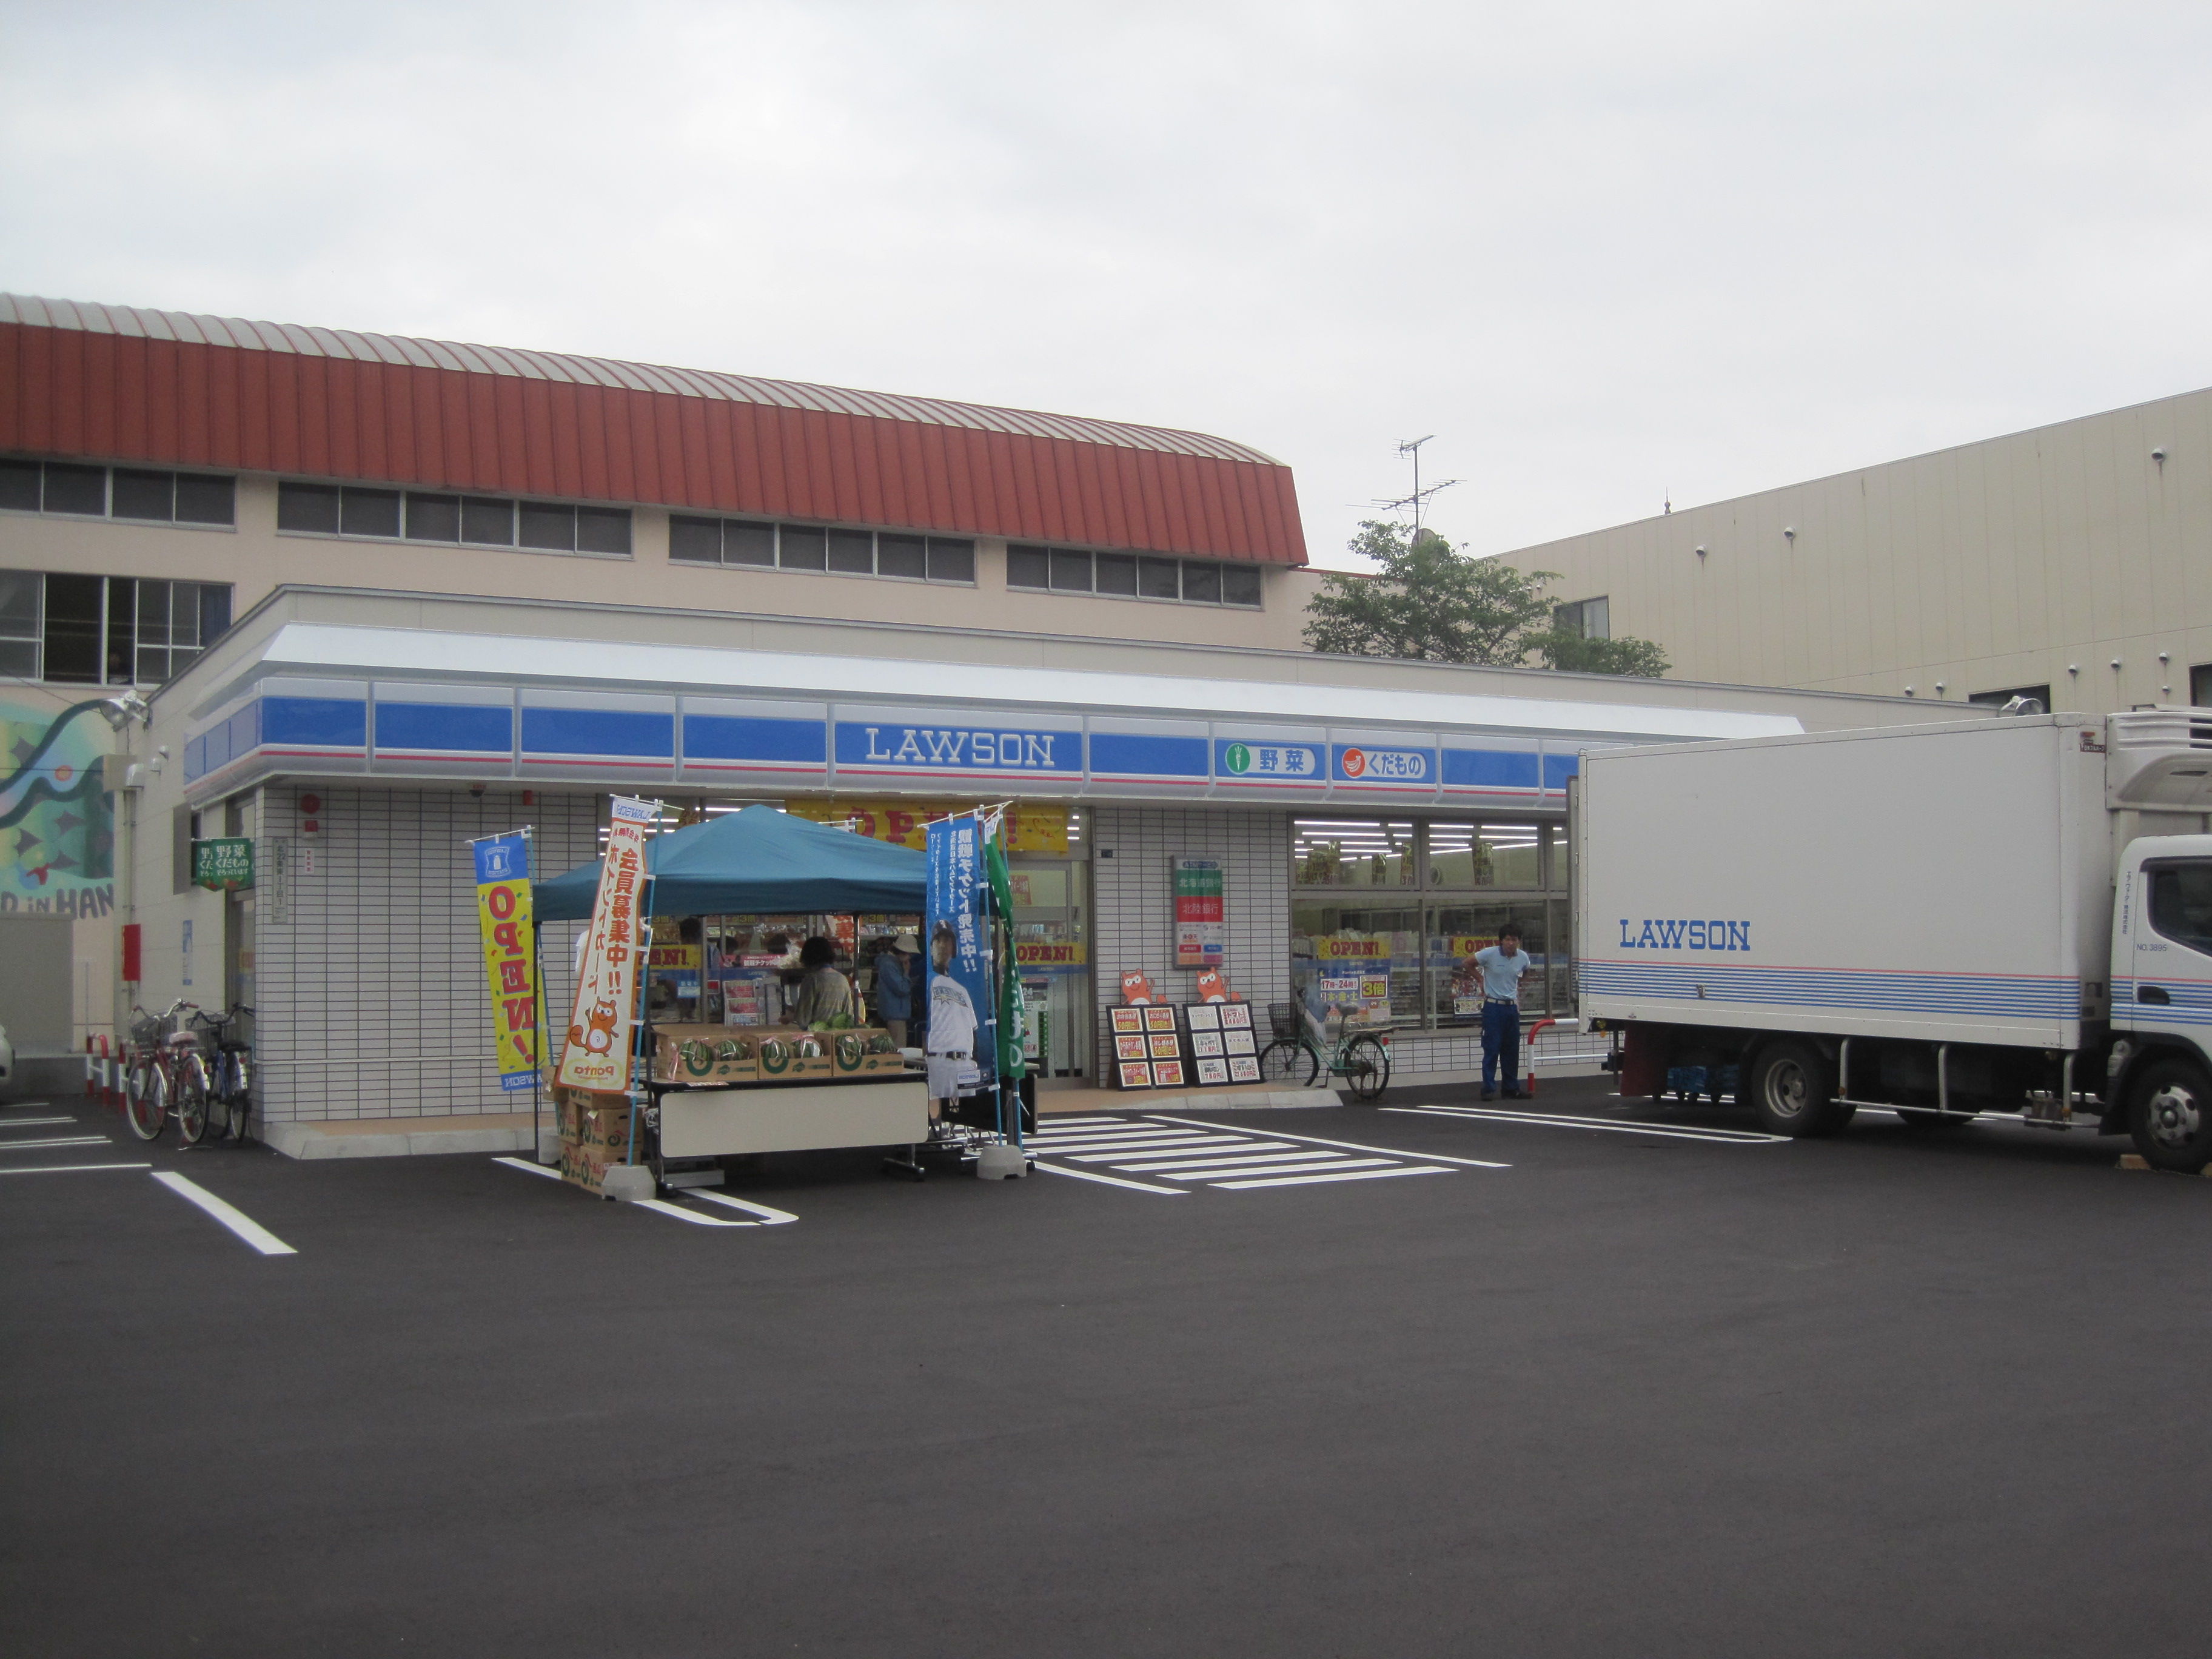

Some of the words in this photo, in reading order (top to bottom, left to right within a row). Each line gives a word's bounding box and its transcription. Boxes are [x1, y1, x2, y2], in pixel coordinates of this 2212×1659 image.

[866, 728, 1054, 767] LAWSON
[1259, 749, 1304, 771] 野菜
[1369, 753, 1421, 776] くだもの
[216, 845, 246, 857] 野菜
[216, 858, 249, 868] くだもの
[1620, 919, 1751, 951] LAWSON
[1016, 945, 1073, 961] OPEN!
[1330, 942, 1379, 956] OPEN!
[1362, 982, 1385, 996] 3倍
